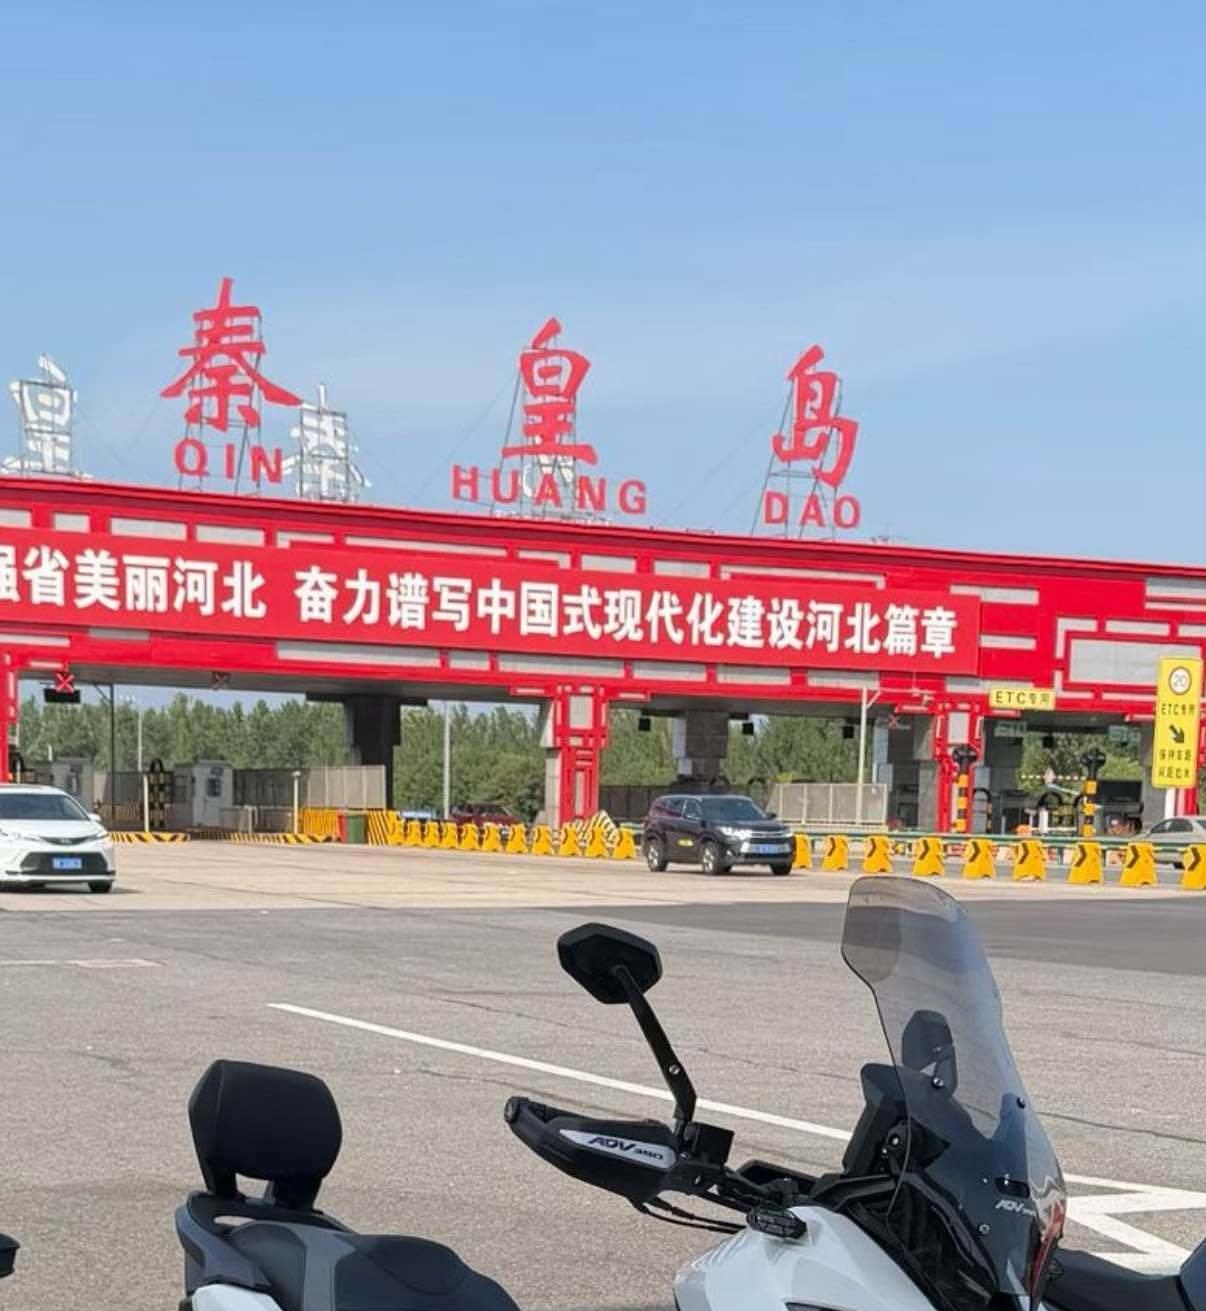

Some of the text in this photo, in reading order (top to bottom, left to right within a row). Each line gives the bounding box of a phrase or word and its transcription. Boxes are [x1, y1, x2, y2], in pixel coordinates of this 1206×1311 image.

[161, 278, 858, 487] 秦 皇 岛
[173, 438, 861, 529] QIN HUANG DAO
[295, 565, 957, 658] 奋力谱写中国式现代化建设河北篇章
[588, 1136, 636, 1152] ADV
